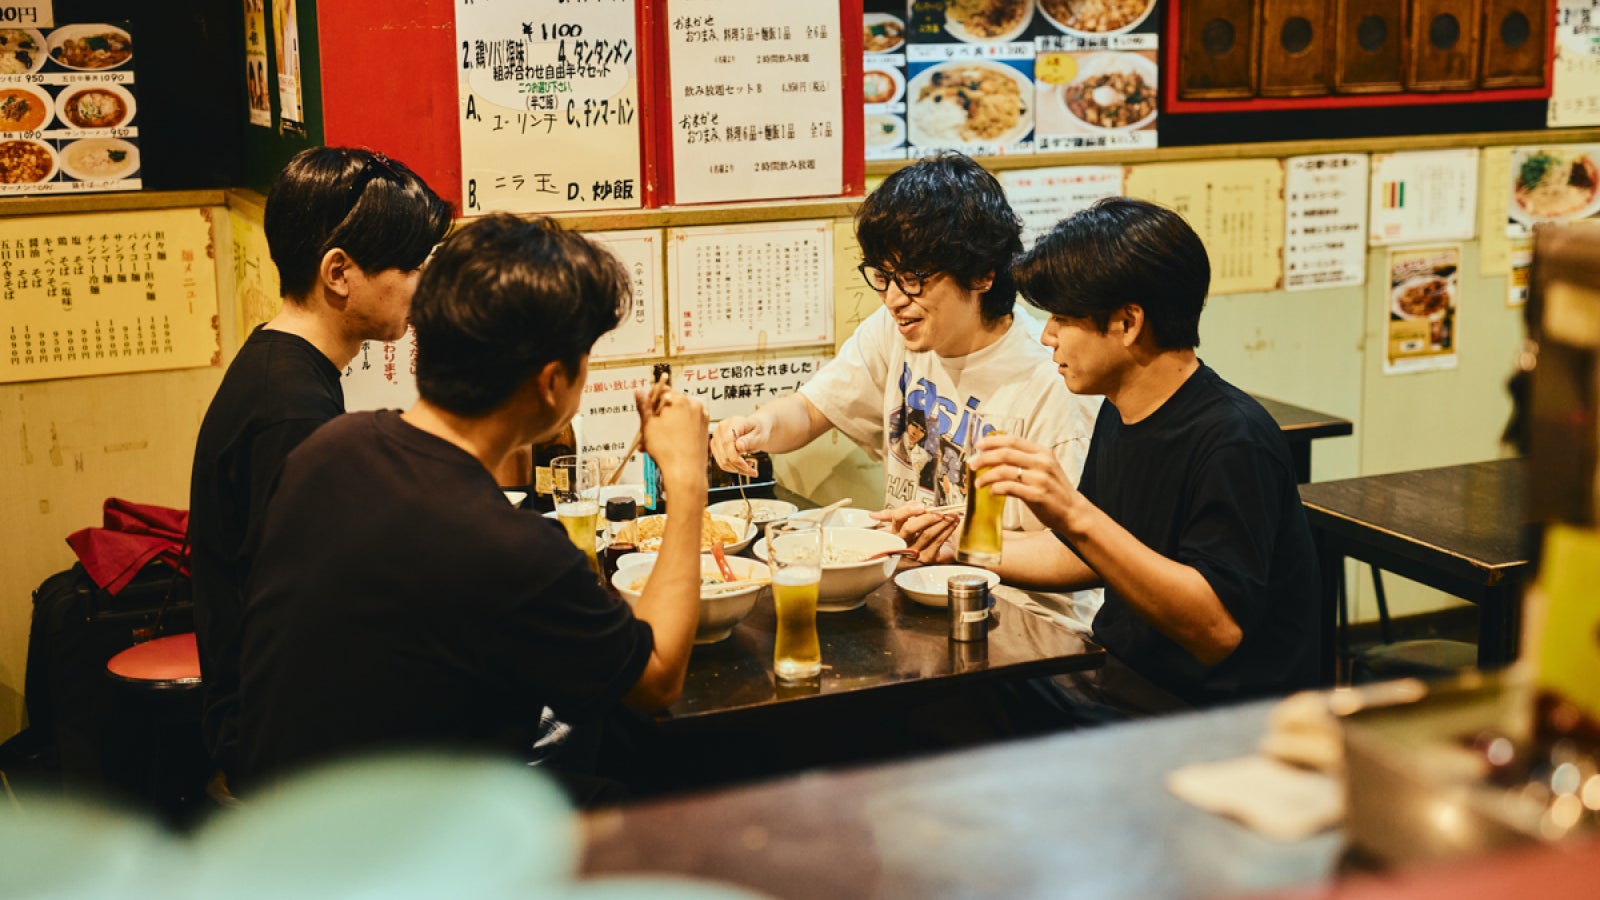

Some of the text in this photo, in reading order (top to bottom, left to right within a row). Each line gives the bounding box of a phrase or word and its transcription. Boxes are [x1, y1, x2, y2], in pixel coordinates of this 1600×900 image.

[0, 7, 37, 23] 0円
[756, 53, 810, 64] 2時間飲み放題
[25, 74, 45, 83] 950
[100, 74, 124, 82] 1090
[493, 64, 611, 81] 組み合わせ自由半々セット
[754, 159, 816, 172] 2時間飲み放題
[155, 231, 167, 260] 担々麺
[1, 240, 14, 300] 五目やきそば
